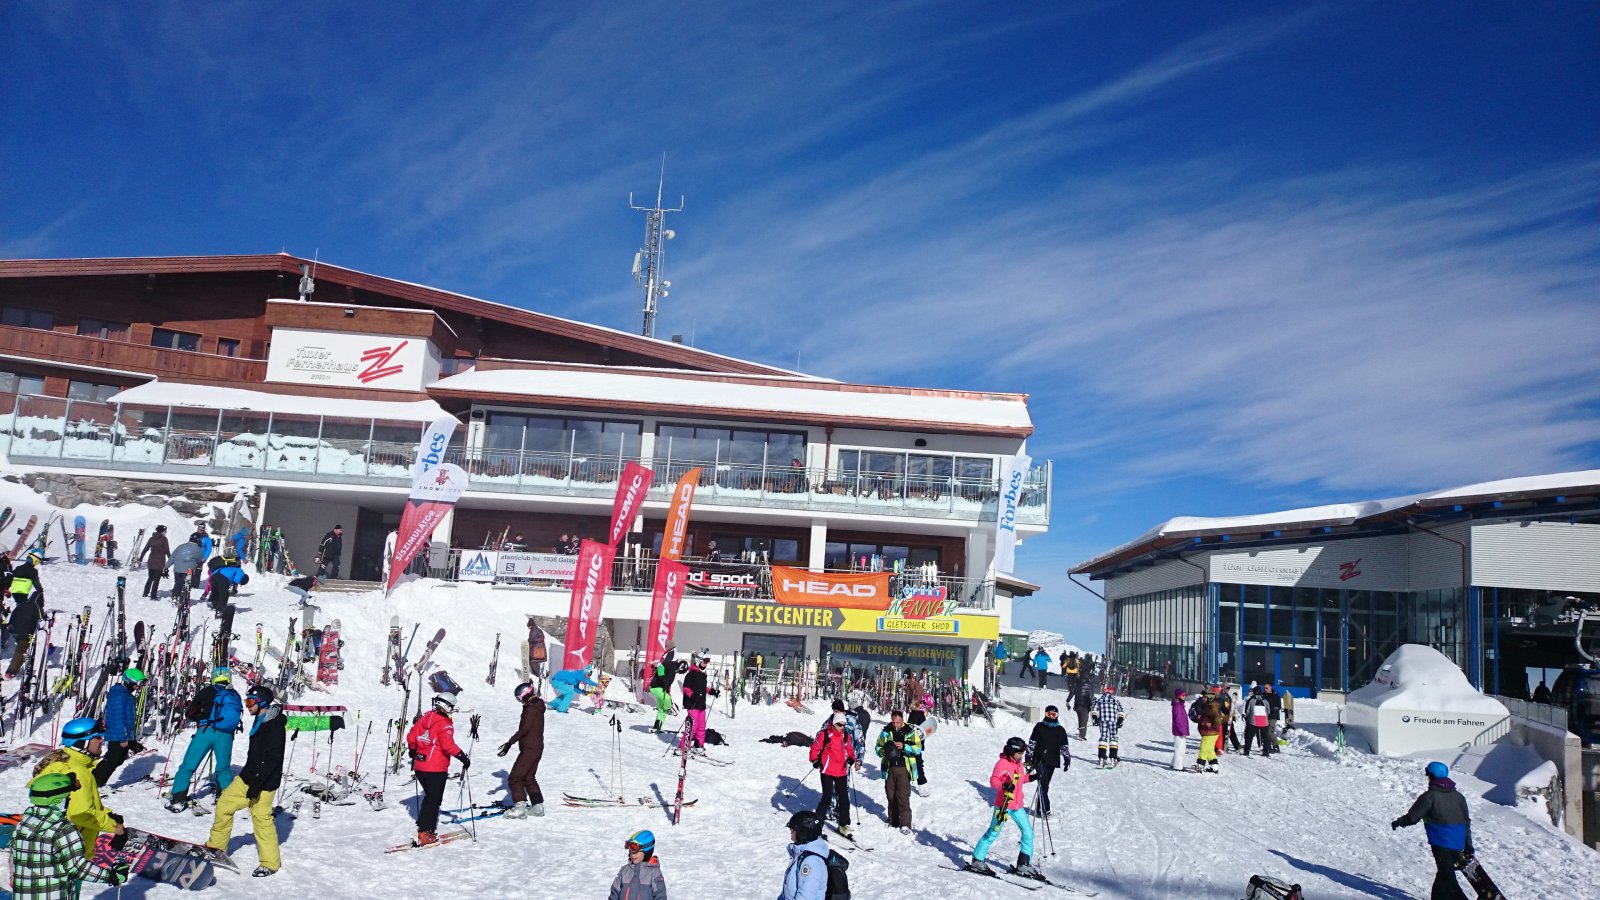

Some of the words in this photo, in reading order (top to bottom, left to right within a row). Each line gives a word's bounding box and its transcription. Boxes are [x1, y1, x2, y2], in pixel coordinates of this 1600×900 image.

[296, 348, 332, 360] Tuxer
[286, 358, 359, 372] Fernerhaus
[613, 473, 642, 541] ATOMIC
[1000, 470, 1022, 533] Forbes
[669, 482, 692, 556] HEAD
[500, 553, 540, 562] atomiclub.hu
[578, 553, 603, 640] ATOMIC
[783, 579, 876, 597] HEAD
[904, 586, 941, 598] SPORT
[657, 571, 677, 651] ATOMIC
[736, 604, 833, 627] TESTCENTER
[885, 598, 958, 617] NENNER
[886, 620, 926, 630] GLETSCHER
[931, 622, 950, 631] SHOP
[831, 643, 841, 653] 10
[843, 643, 864, 654] MIN.
[867, 645, 957, 660] EXPRESS-SKISERVICE
[1413, 716, 1441, 724] Freude
[1457, 718, 1485, 727] Fahren
